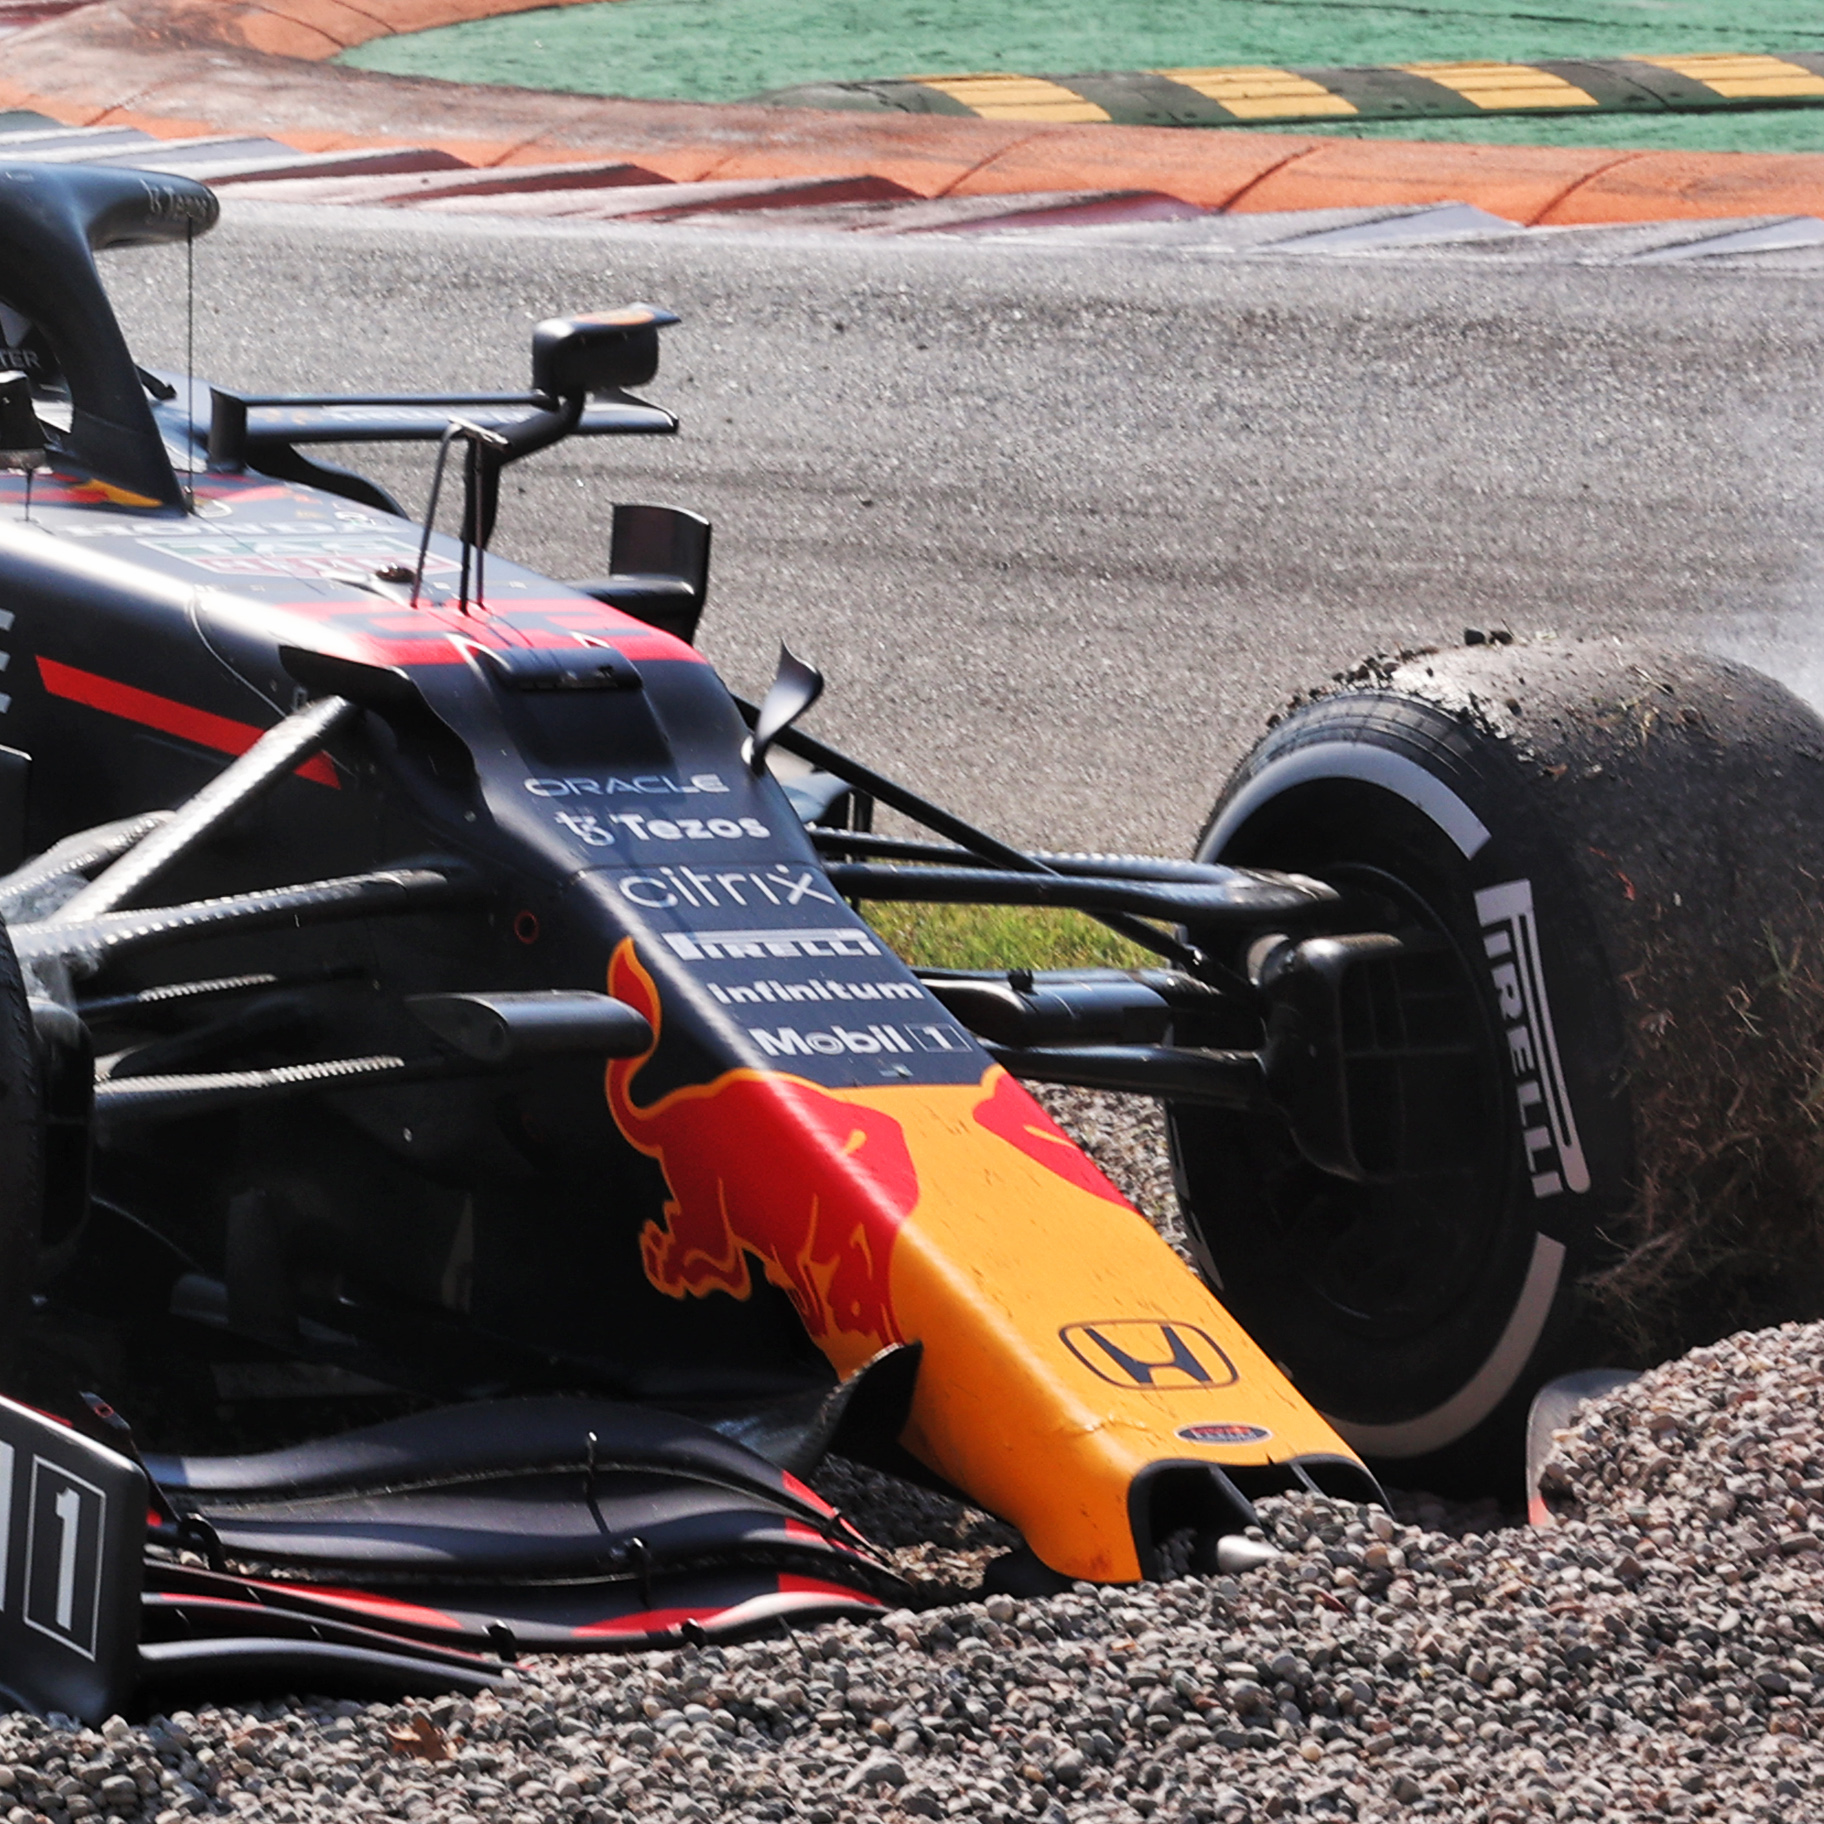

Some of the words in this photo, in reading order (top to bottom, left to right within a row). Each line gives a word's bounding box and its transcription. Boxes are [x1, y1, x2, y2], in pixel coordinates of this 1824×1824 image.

[524, 774, 730, 798] ORACLE
[610, 812, 771, 842] Tezos
[619, 864, 836, 909] citrix
[662, 927, 882, 961] PIRELLI
[750, 1024, 912, 1057] Mobil
[1473, 878, 1591, 1198] PIRELLI
[53, 1487, 82, 1631] 1
